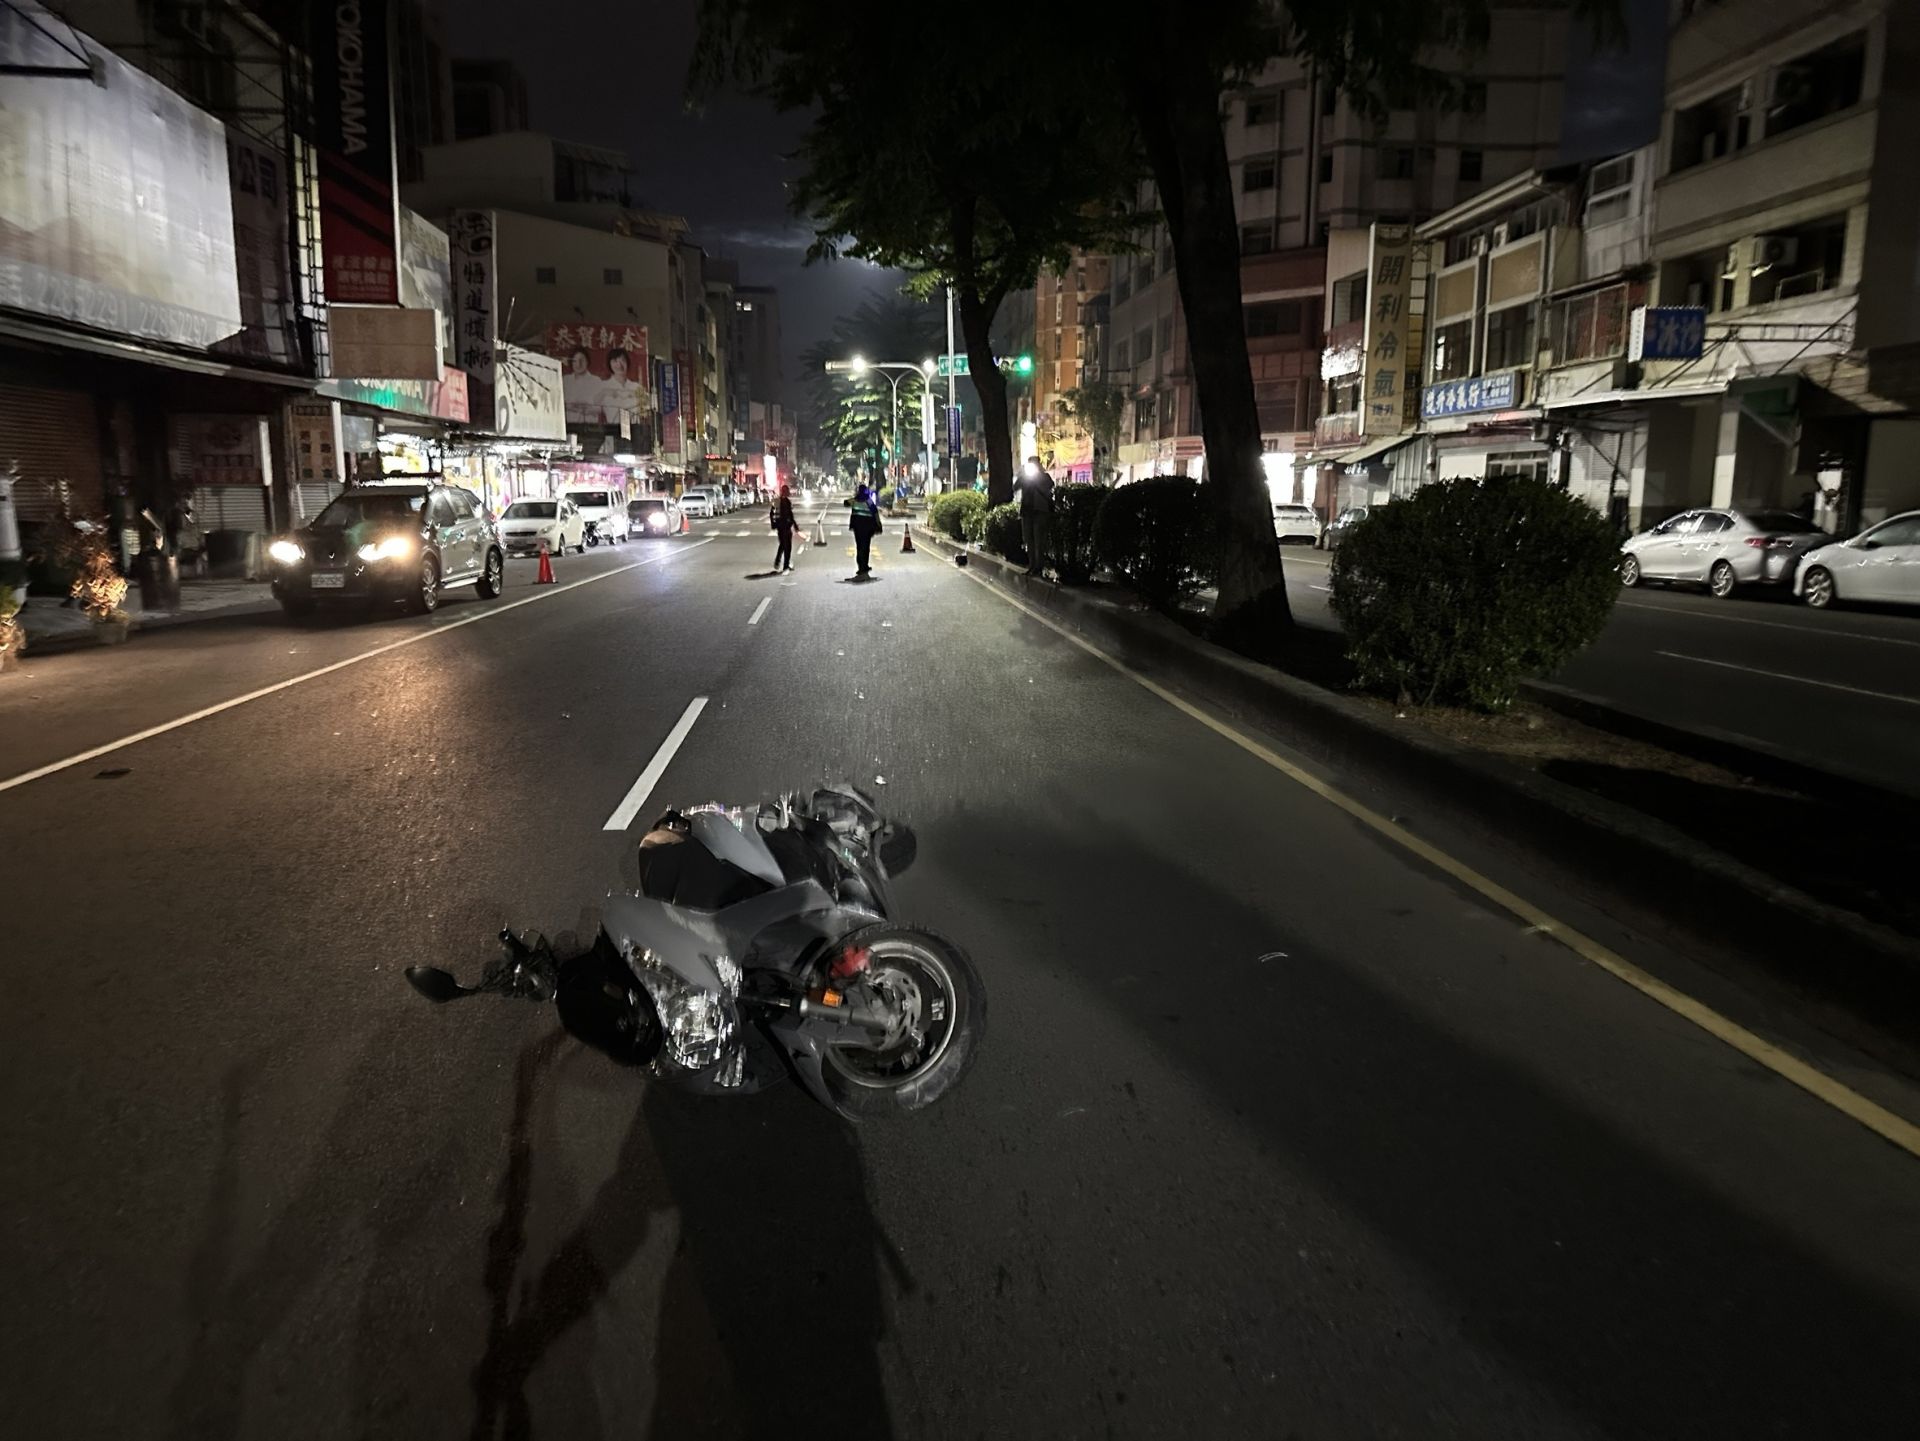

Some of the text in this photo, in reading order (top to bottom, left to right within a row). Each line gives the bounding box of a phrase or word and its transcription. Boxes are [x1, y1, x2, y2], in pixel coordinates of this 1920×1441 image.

[336, 0, 367, 155] OKOHAMA
[552, 324, 643, 352] 恭賀新春
[1375, 255, 1405, 398] 開利冷氣
